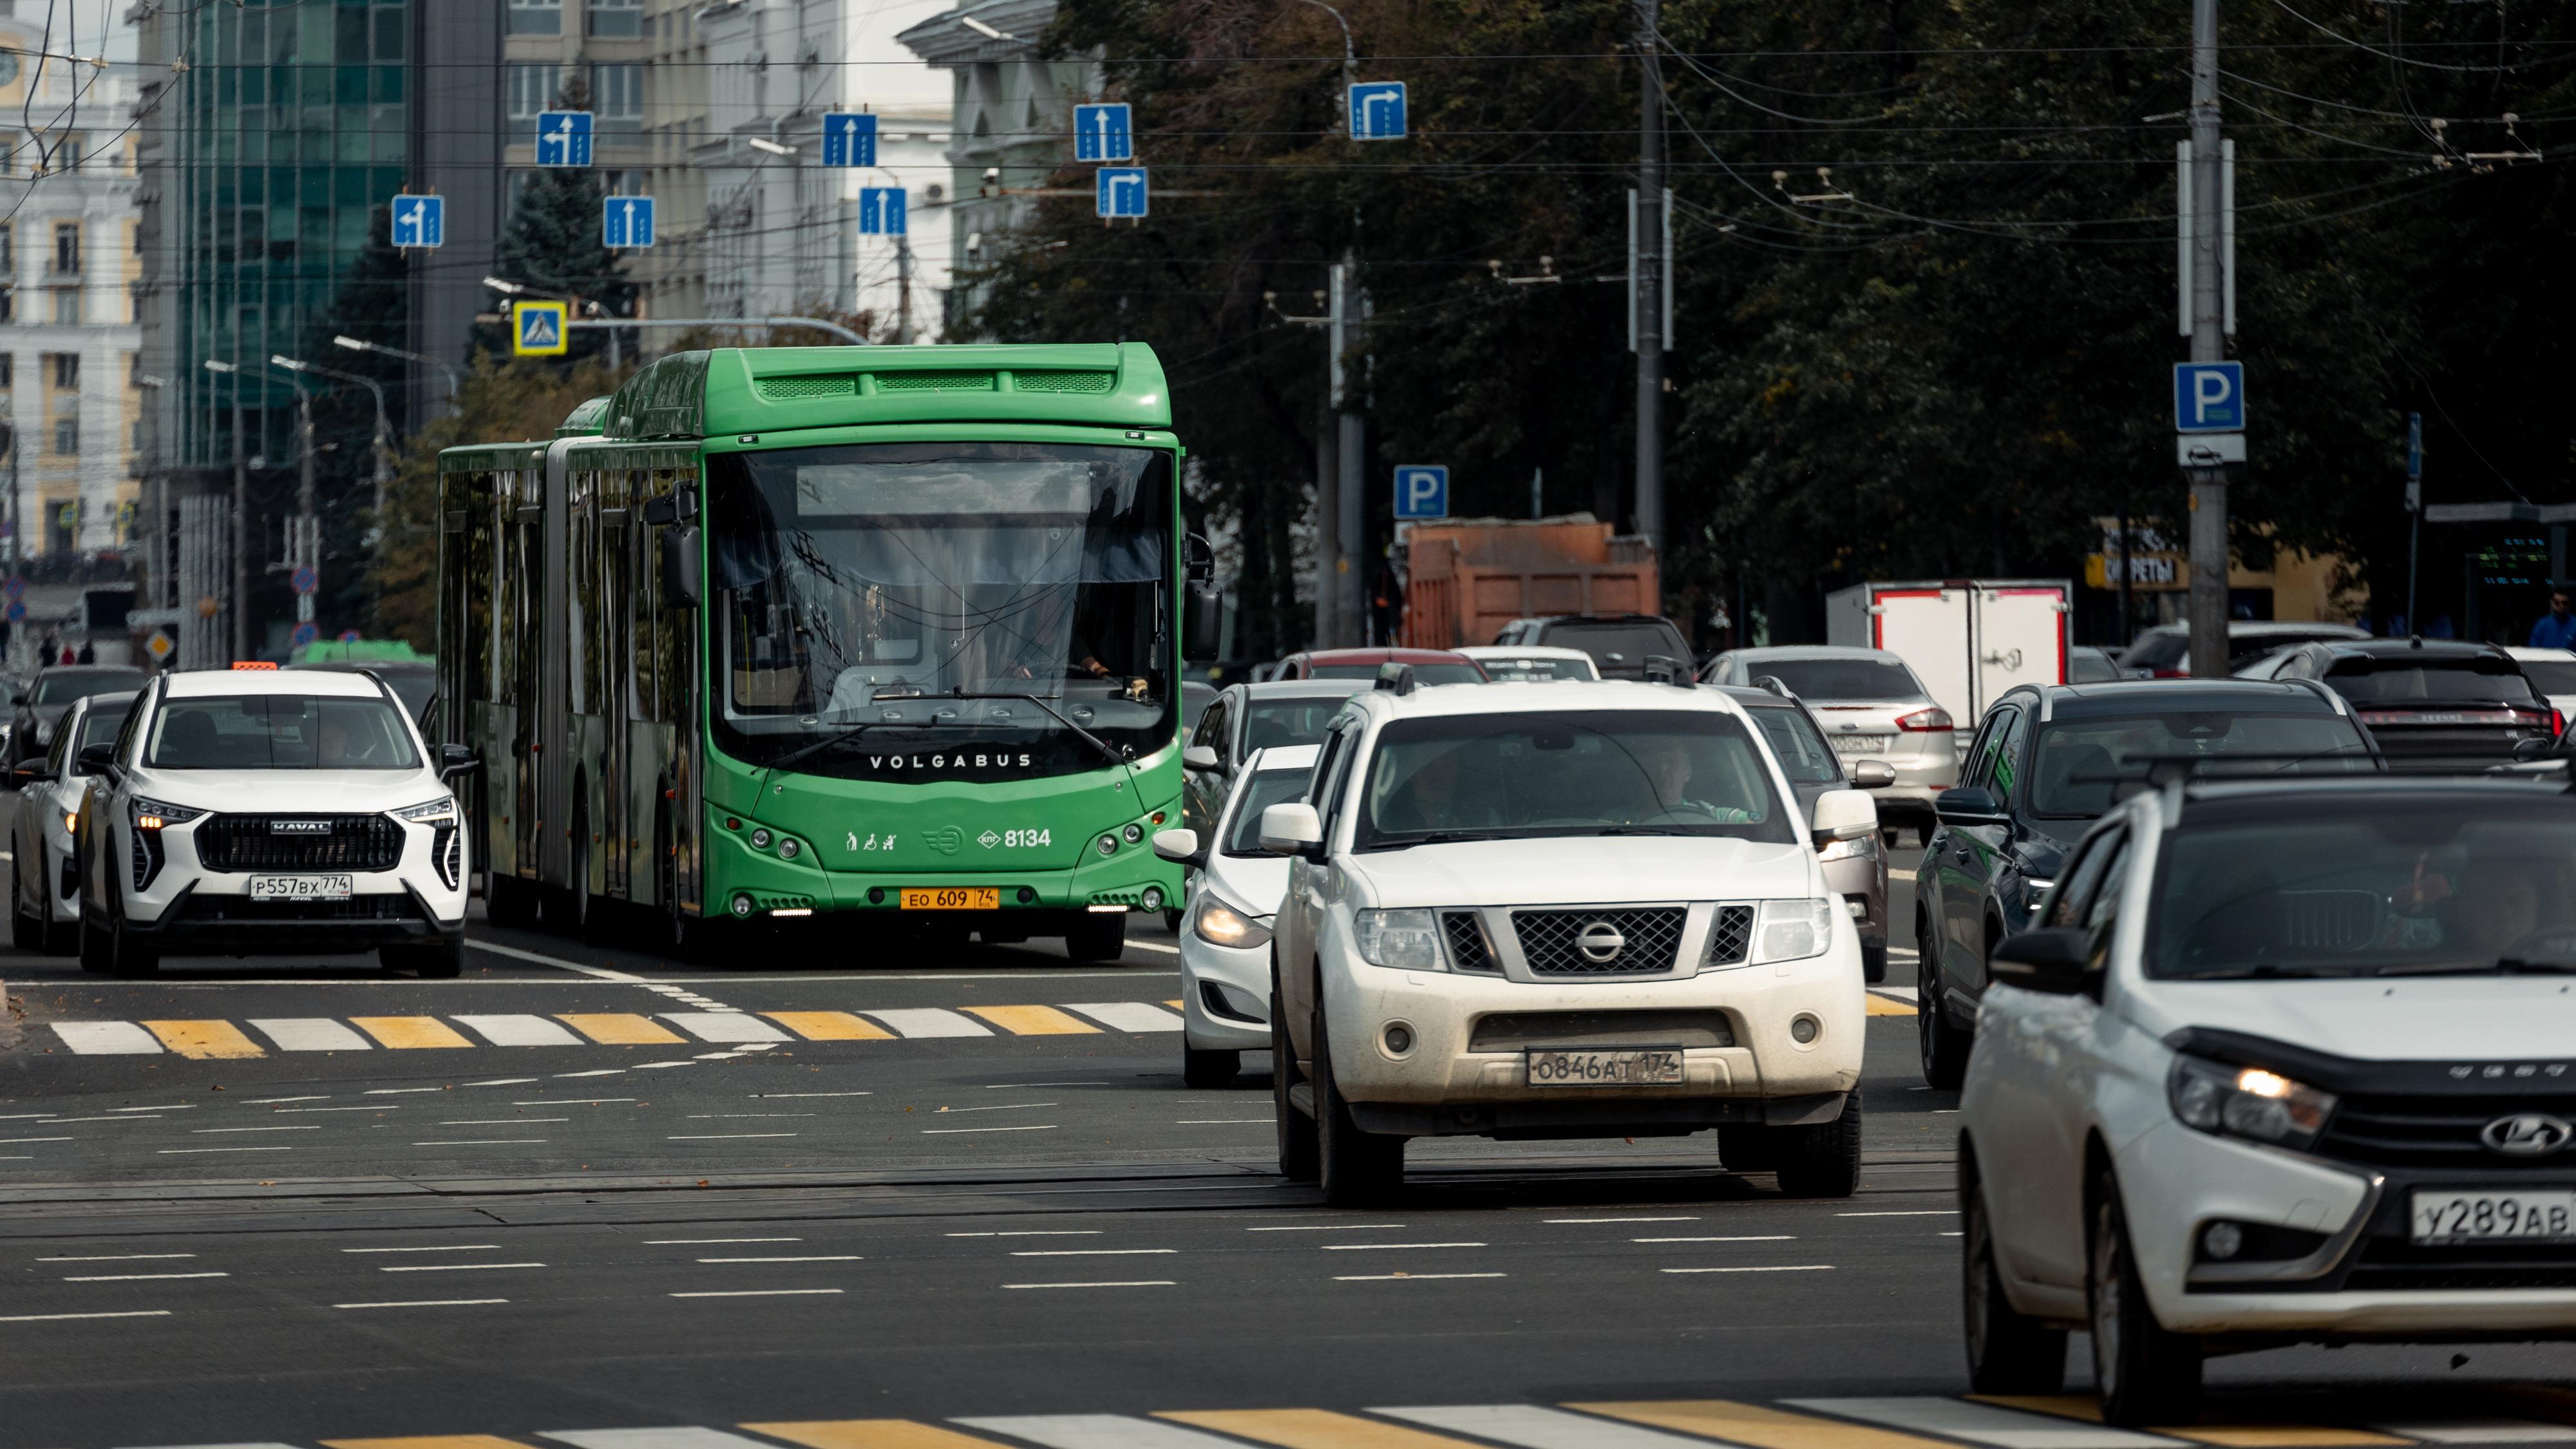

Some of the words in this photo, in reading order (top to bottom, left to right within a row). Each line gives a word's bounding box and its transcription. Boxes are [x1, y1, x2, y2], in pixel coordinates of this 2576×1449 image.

[2194, 370, 2231, 424] P
[1409, 472, 1439, 513] P
[870, 754, 1030, 769] VOLGABUS
[273, 823, 329, 831] HAVAL
[1005, 829, 1051, 848] 8134
[937, 890, 967, 907] 609
[977, 889, 993, 902] 74
